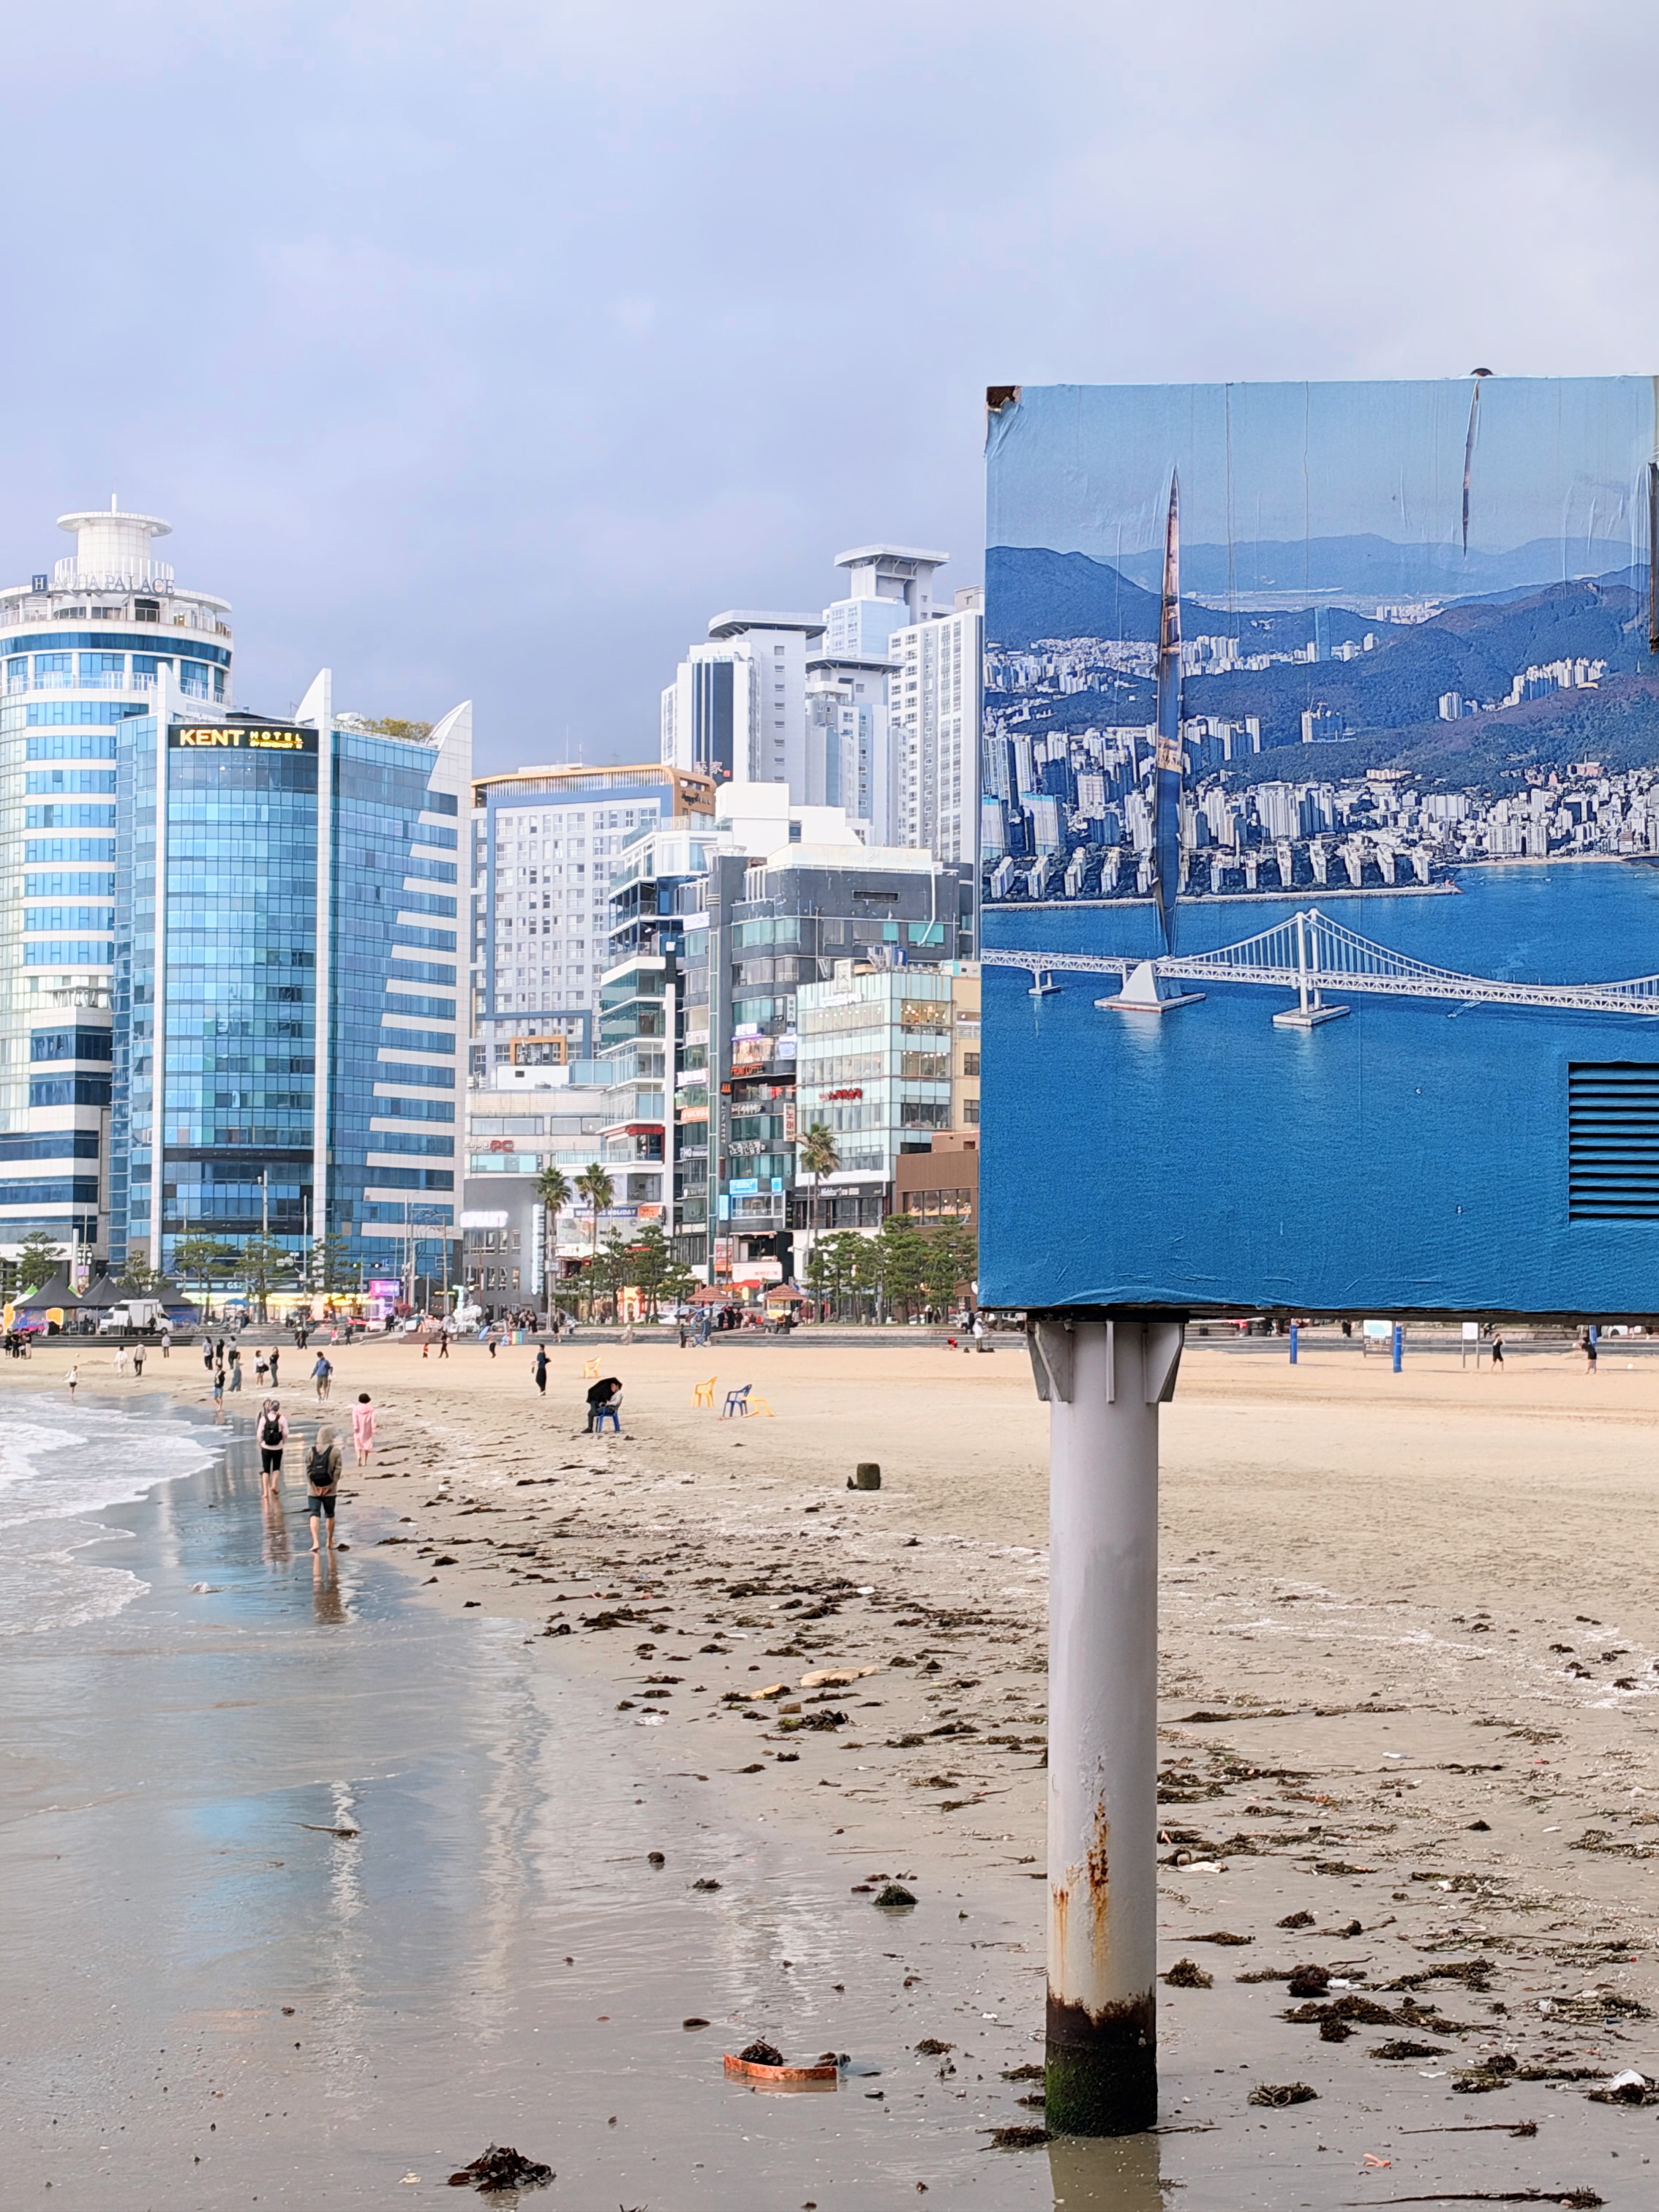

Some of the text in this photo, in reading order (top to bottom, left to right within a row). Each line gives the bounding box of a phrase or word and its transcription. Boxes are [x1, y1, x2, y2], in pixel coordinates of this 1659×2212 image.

[105, 574, 175, 595] PALACE
[180, 729, 245, 746] KENT
[249, 731, 302, 742] HOTEL
